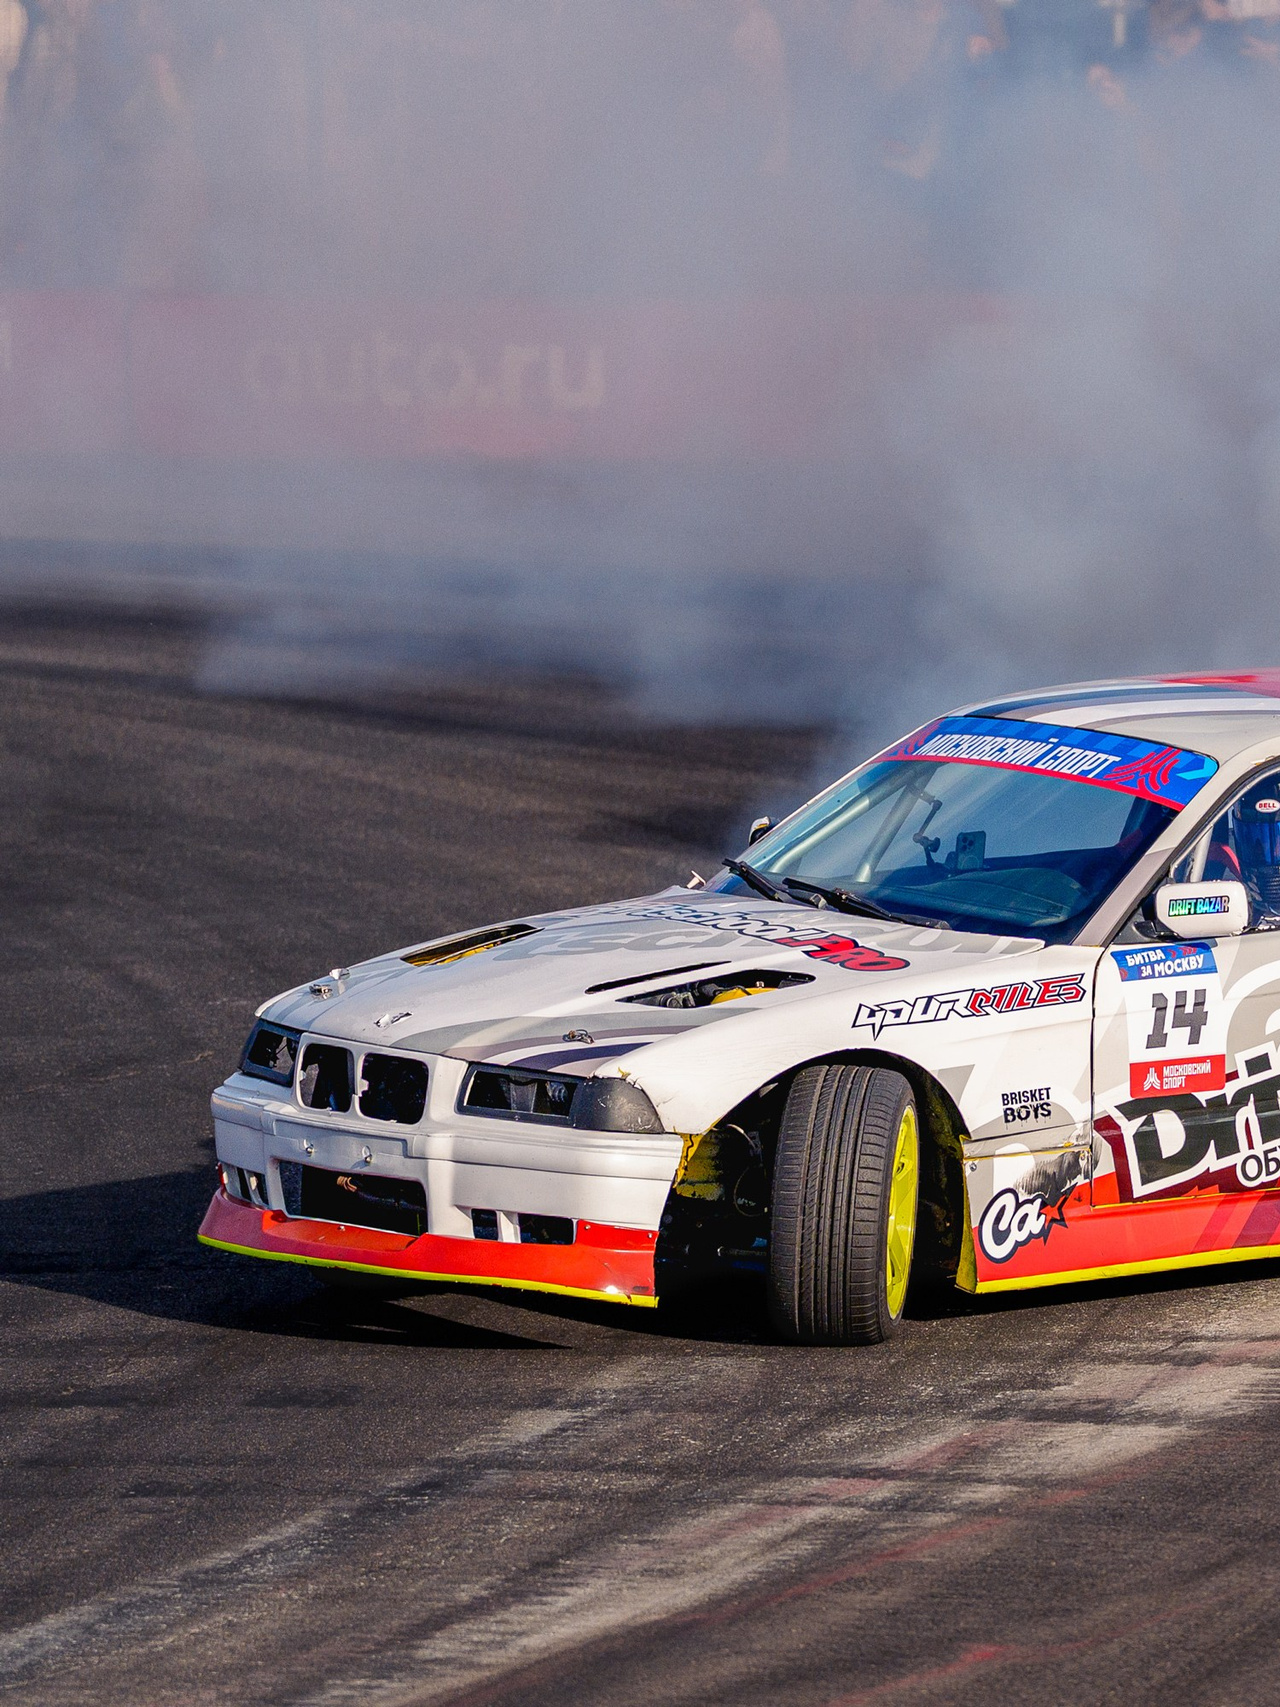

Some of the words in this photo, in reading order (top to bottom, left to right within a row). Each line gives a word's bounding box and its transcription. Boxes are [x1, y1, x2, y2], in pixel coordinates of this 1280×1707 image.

[244, 328, 606, 409] auto.ru
[912, 733, 1059, 766] МОСКОВСКИЙ
[1034, 745, 1122, 778] СПОРТ
[1169, 899, 1196, 916] DRIFT
[1196, 896, 1229, 914] BAZAR
[1125, 949, 1166, 967] БИТВА
[1141, 965, 1153, 978] ЗА
[1154, 954, 1204, 978] МОСКВУ
[1145, 988, 1208, 1049] 14
[1162, 1060, 1212, 1078] МОСКОВСКИЙ
[1162, 1076, 1186, 1090] СПОРТ
[1001, 1087, 1051, 1107] BRISKET
[1003, 1102, 1052, 1124] BOYS
